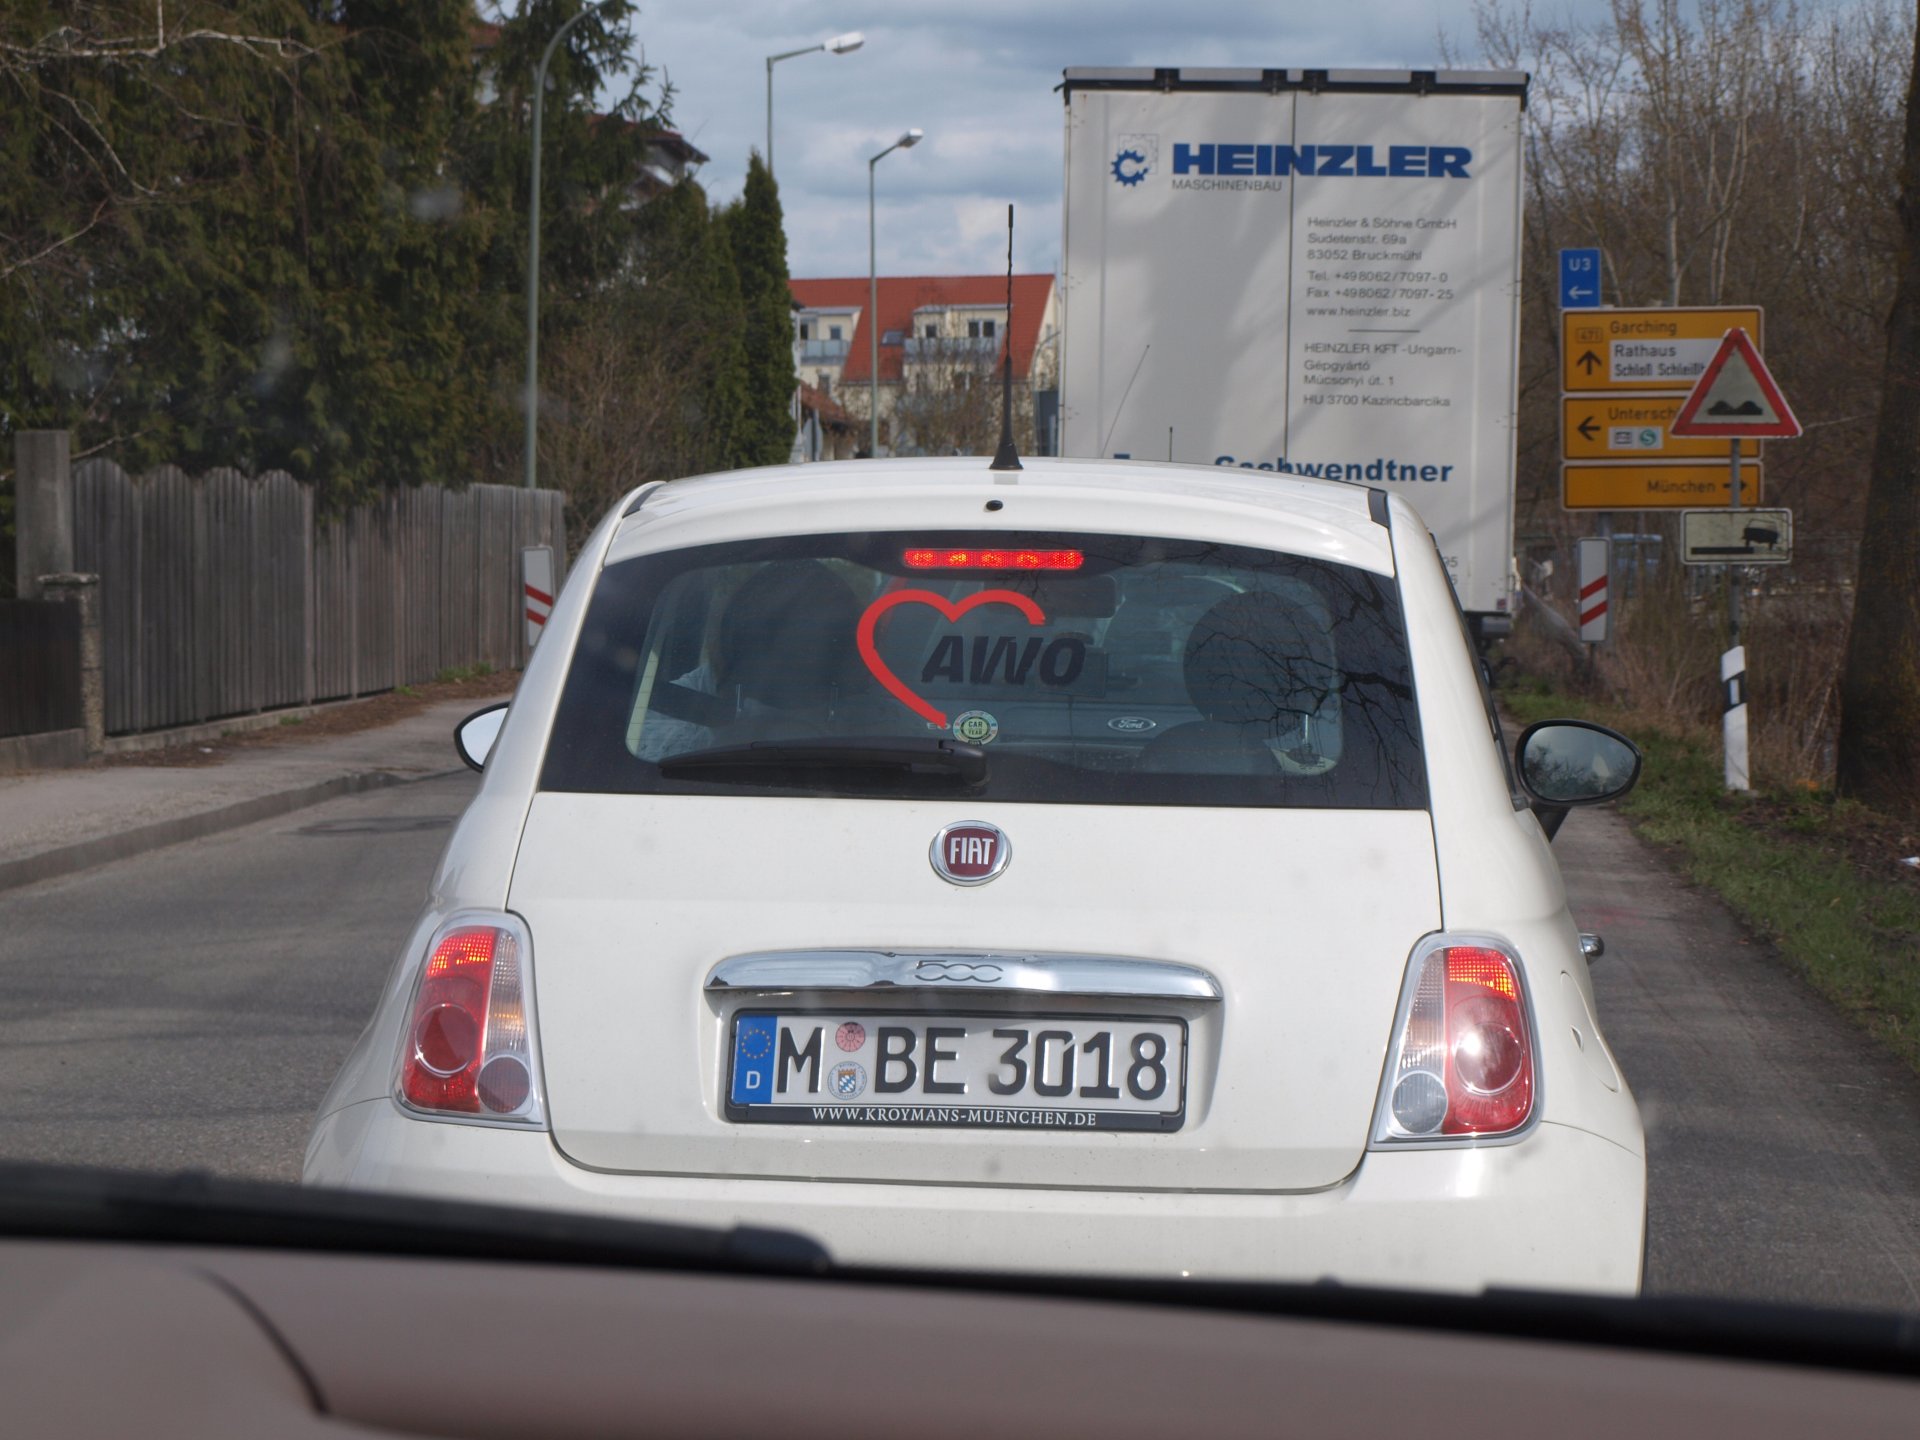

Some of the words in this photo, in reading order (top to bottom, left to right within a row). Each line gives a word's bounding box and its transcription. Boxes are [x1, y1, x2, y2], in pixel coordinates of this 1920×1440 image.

[1173, 143, 1472, 179] HEINZLER
[1172, 178, 1282, 192] MASCHINENBAU
[1307, 217, 1358, 228] Heinzler
[1360, 218, 1369, 228] &
[1372, 217, 1413, 229] Söhne
[1415, 218, 1457, 229] GmbH
[1307, 233, 1378, 244] Sudetenstr.
[1382, 234, 1407, 245] 69a
[1306, 250, 1348, 261] 83052
[1352, 249, 1422, 261] Bruckmühl
[1568, 257, 1592, 272] U3
[1308, 270, 1329, 281] Tel.
[1306, 287, 1329, 298] Fax
[1306, 305, 1411, 317] www.heinzler.biz
[1610, 320, 1678, 336] Garching
[1304, 343, 1370, 354] HEINZLER
[1374, 343, 1399, 354] KFT
[1614, 344, 1677, 358] Rathaus
[1388, 376, 1395, 386] 1
[1303, 394, 1324, 405] HU
[1327, 394, 1359, 406] 3700
[1361, 395, 1451, 407] Kazincbarcika
[1647, 481, 1716, 494] München
[921, 635, 1086, 685] AWO
[949, 836, 995, 865] FIAT
[914, 960, 1004, 983] 500
[776, 1026, 825, 1094] M
[874, 1027, 968, 1094] BE
[988, 1029, 1168, 1101] 3018
[745, 1070, 761, 1090] D
[812, 1107, 1097, 1126] WWW.KROYMANS-MUENCHEN.DE
